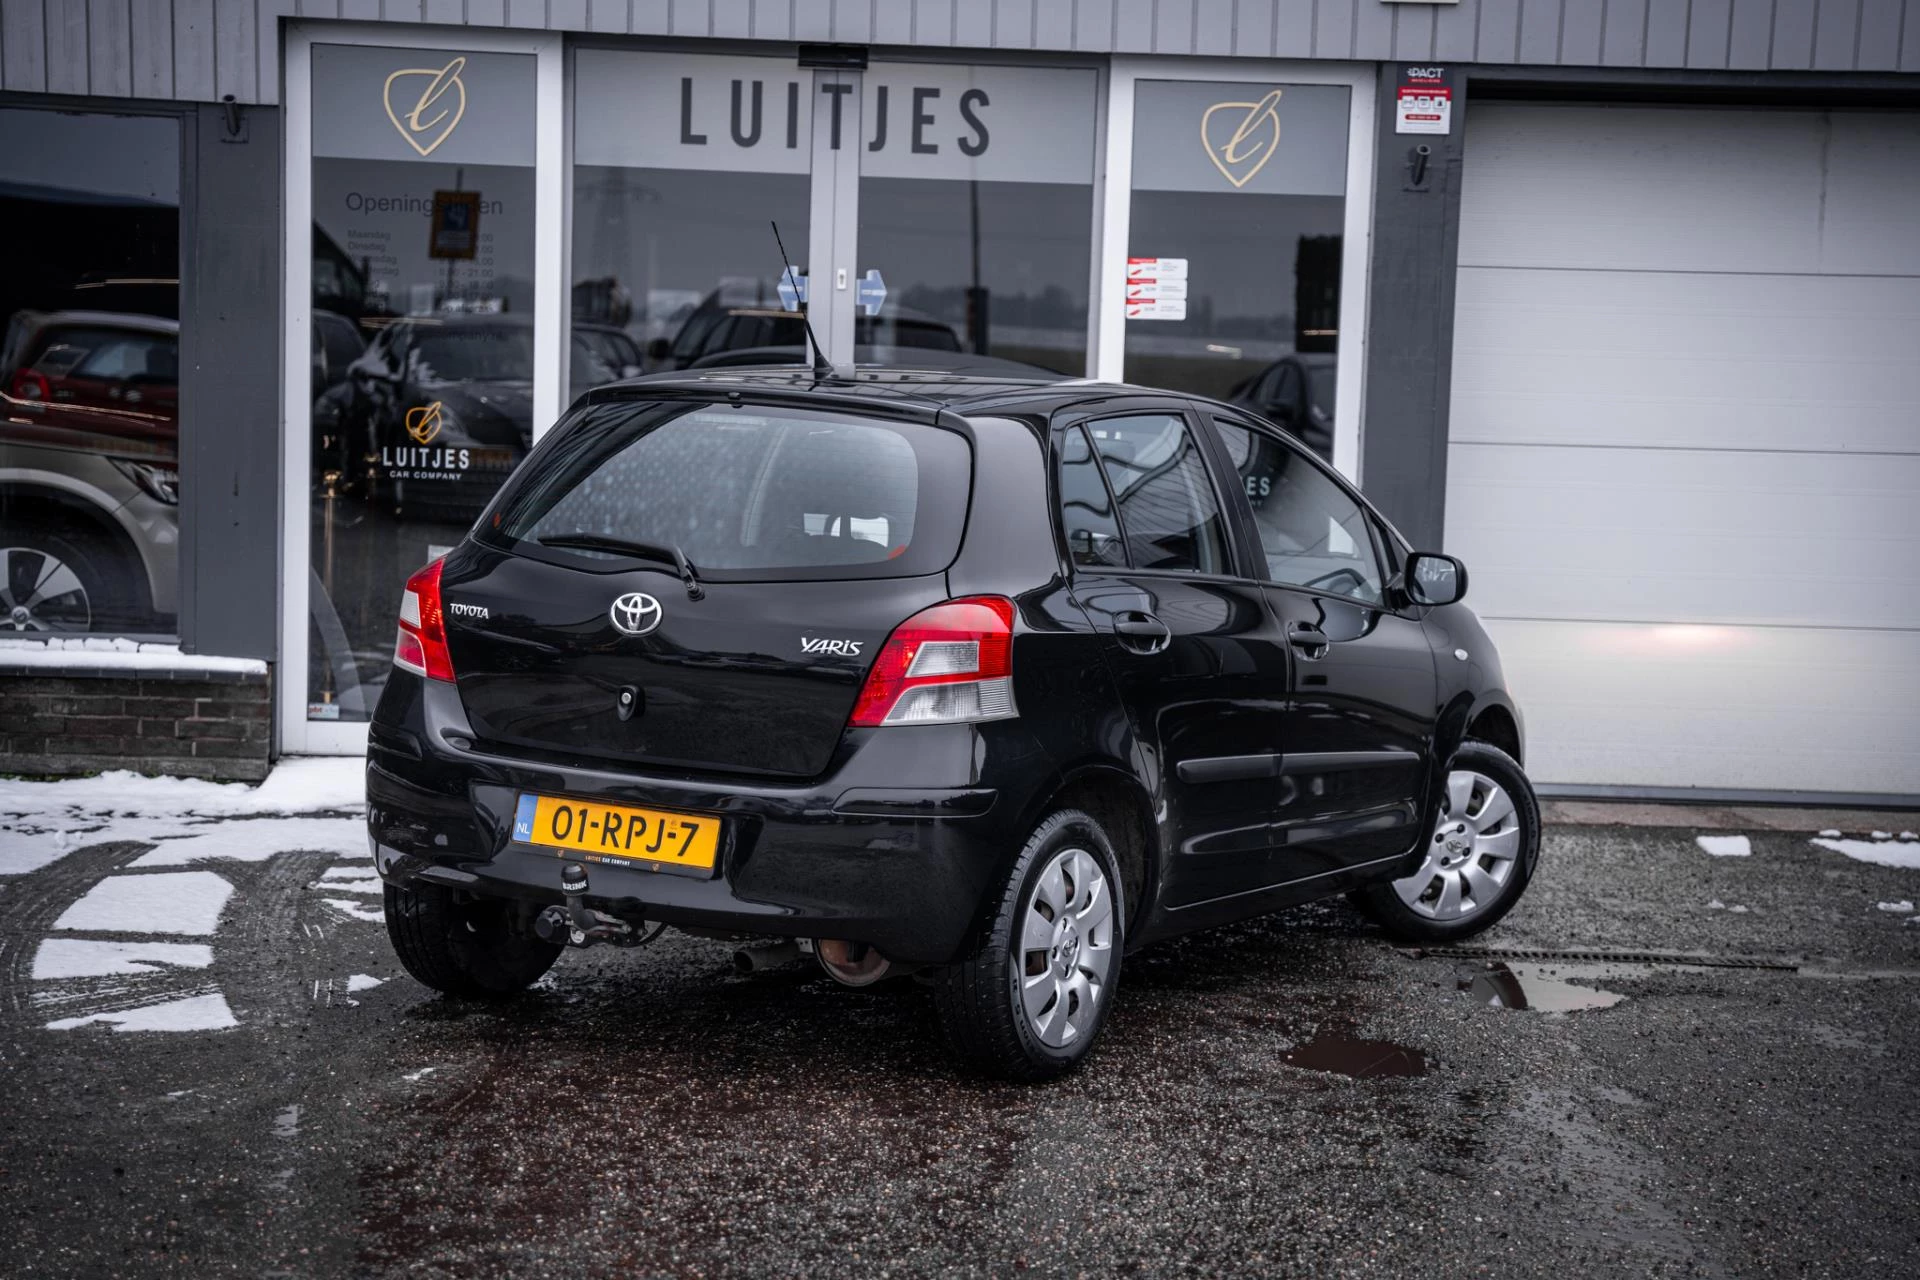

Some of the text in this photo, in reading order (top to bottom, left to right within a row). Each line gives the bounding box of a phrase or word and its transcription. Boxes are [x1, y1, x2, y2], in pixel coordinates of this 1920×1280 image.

[680, 77, 990, 157] LUITJES
[346, 192, 503, 217] Openingen
[382, 446, 470, 469] LUITJES
[389, 470, 462, 480] CAR COMPANY
[1245, 475, 1271, 496] ES
[450, 603, 489, 619] TOYOTA
[517, 822, 530, 834] NL
[551, 805, 700, 857] 01-RPJ-7
[562, 880, 587, 890] BRINK
